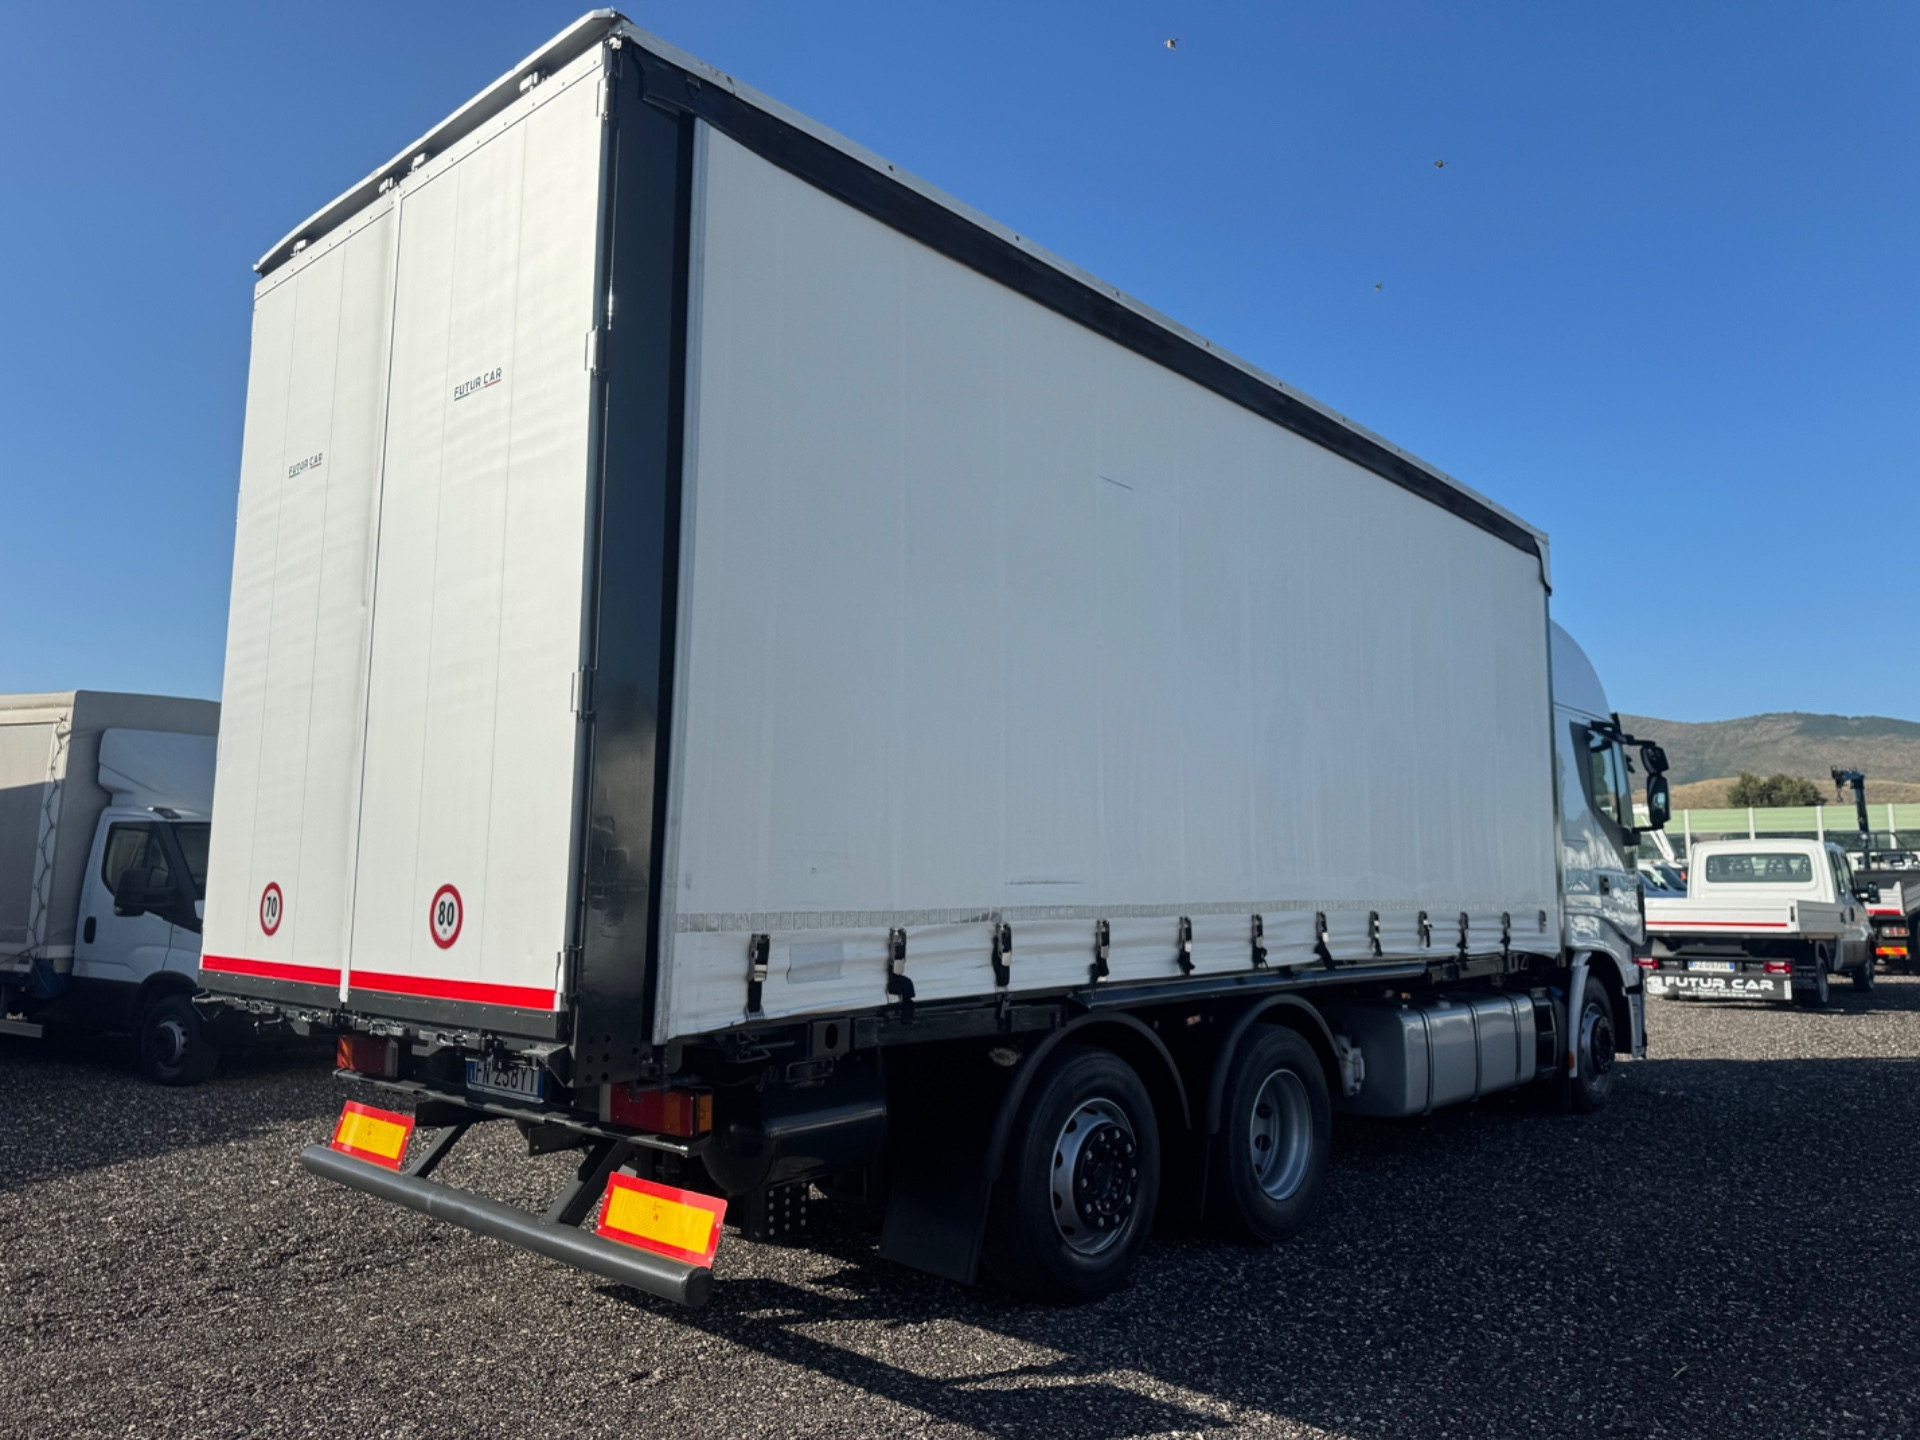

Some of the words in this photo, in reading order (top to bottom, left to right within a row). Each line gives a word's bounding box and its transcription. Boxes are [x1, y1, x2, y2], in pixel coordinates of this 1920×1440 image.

[454, 376, 481, 398] FUTUR
[484, 367, 503, 384] CAR
[289, 459, 309, 476] FUTUR
[310, 453, 323, 466] CAR
[265, 896, 278, 918] 70
[437, 900, 455, 927] 80
[1664, 975, 1726, 989] FUTUR
[1731, 978, 1775, 991] CAR
